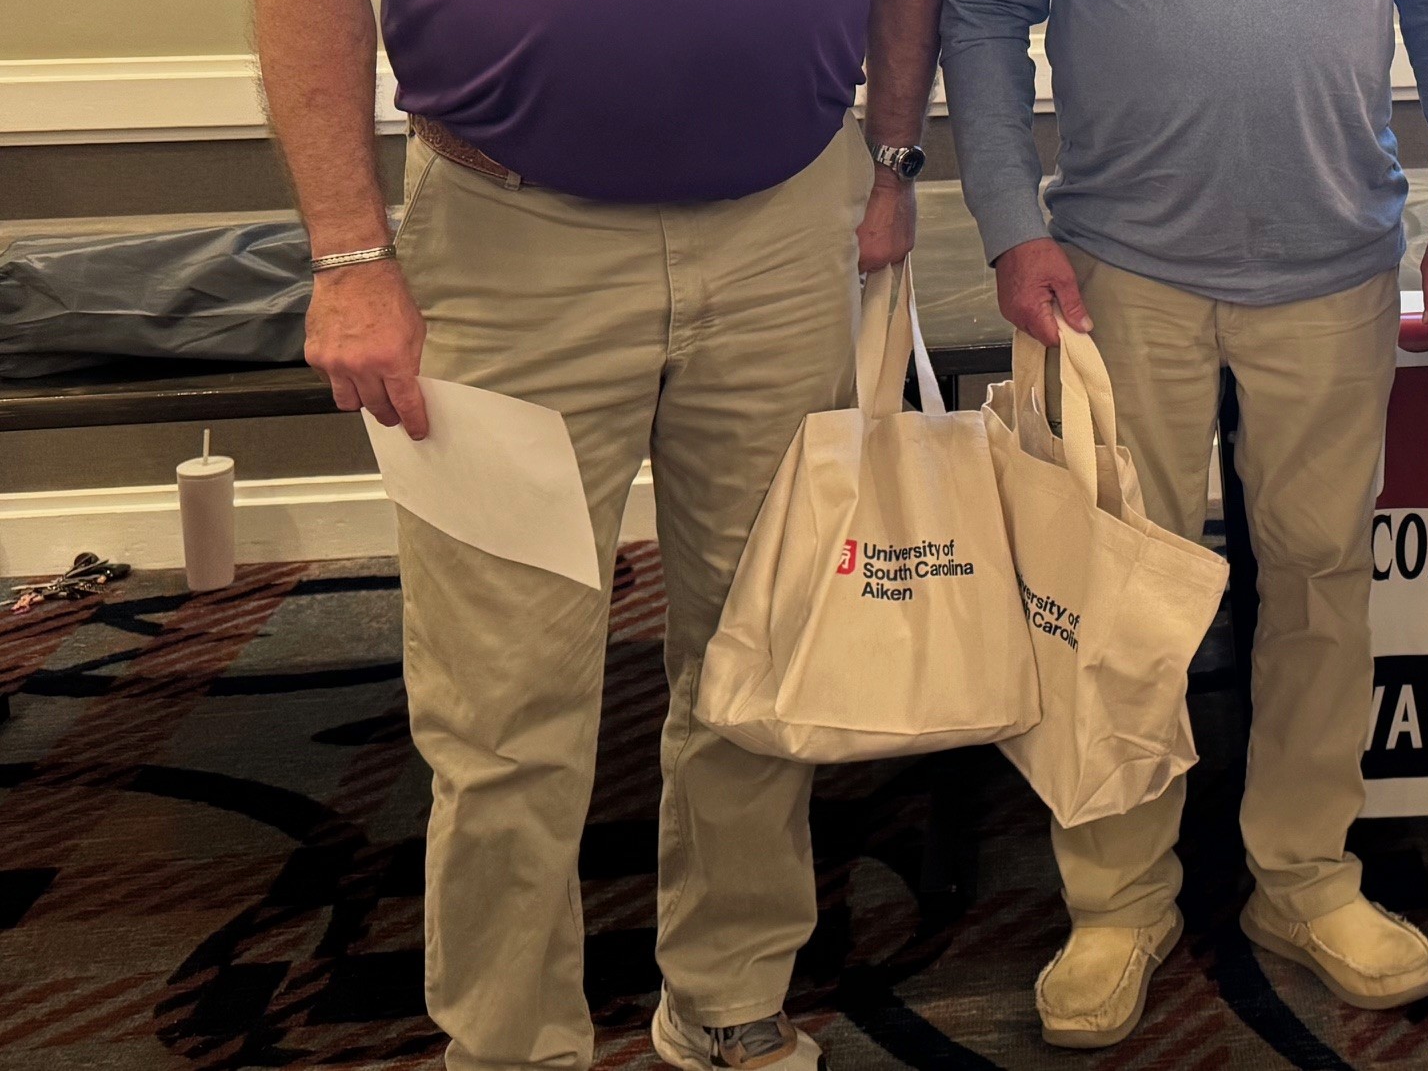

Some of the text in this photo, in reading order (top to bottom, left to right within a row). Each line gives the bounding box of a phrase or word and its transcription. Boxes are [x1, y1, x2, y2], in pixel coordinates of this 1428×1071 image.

[863, 539, 955, 562] University of
[863, 560, 974, 581] South Carolina
[861, 581, 913, 601] Aiken
[1067, 611, 1081, 630] of
